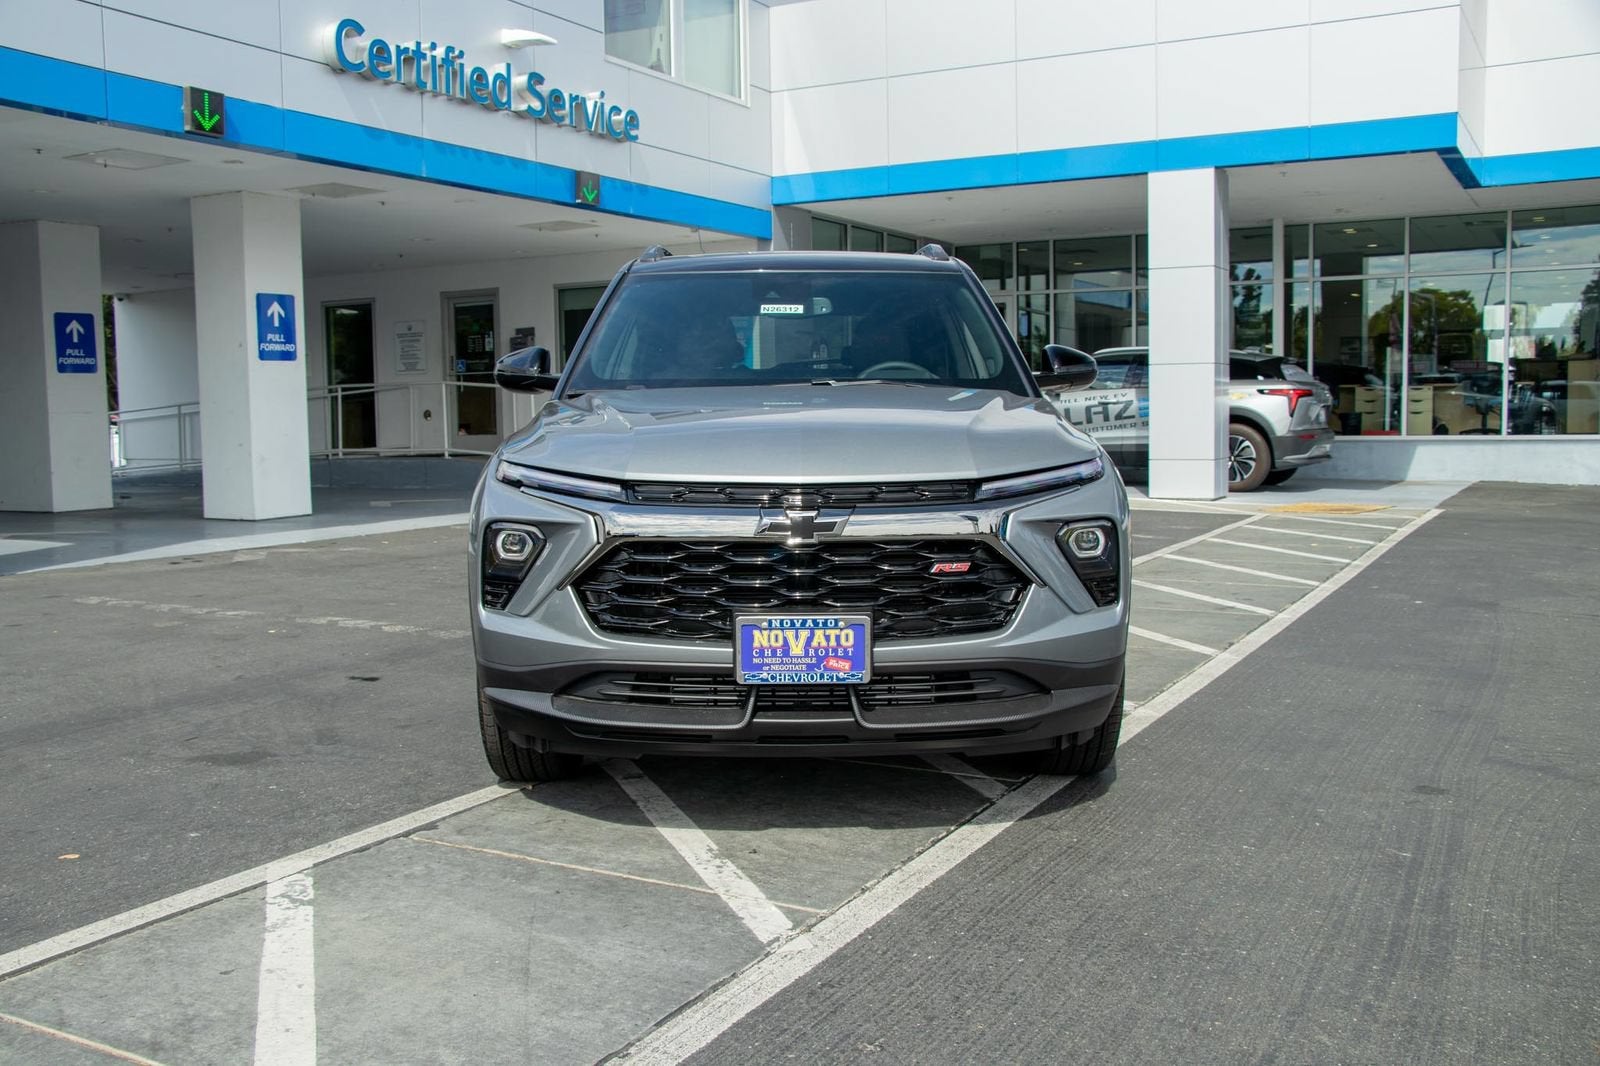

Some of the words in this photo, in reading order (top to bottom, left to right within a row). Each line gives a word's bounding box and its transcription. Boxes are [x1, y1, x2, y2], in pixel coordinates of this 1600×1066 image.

[334, 18, 511, 111] Certified
[526, 71, 640, 142] Service
[266, 333, 286, 341] PULL
[260, 343, 296, 351] FORWARD
[65, 348, 86, 356] PULL
[58, 357, 96, 365] FORWARD
[1084, 422, 1137, 434] USTOMER
[931, 562, 971, 573] RS
[771, 619, 835, 628] NOVATO
[753, 629, 854, 656] NOVATO
[768, 672, 838, 682] CHEVROLET
